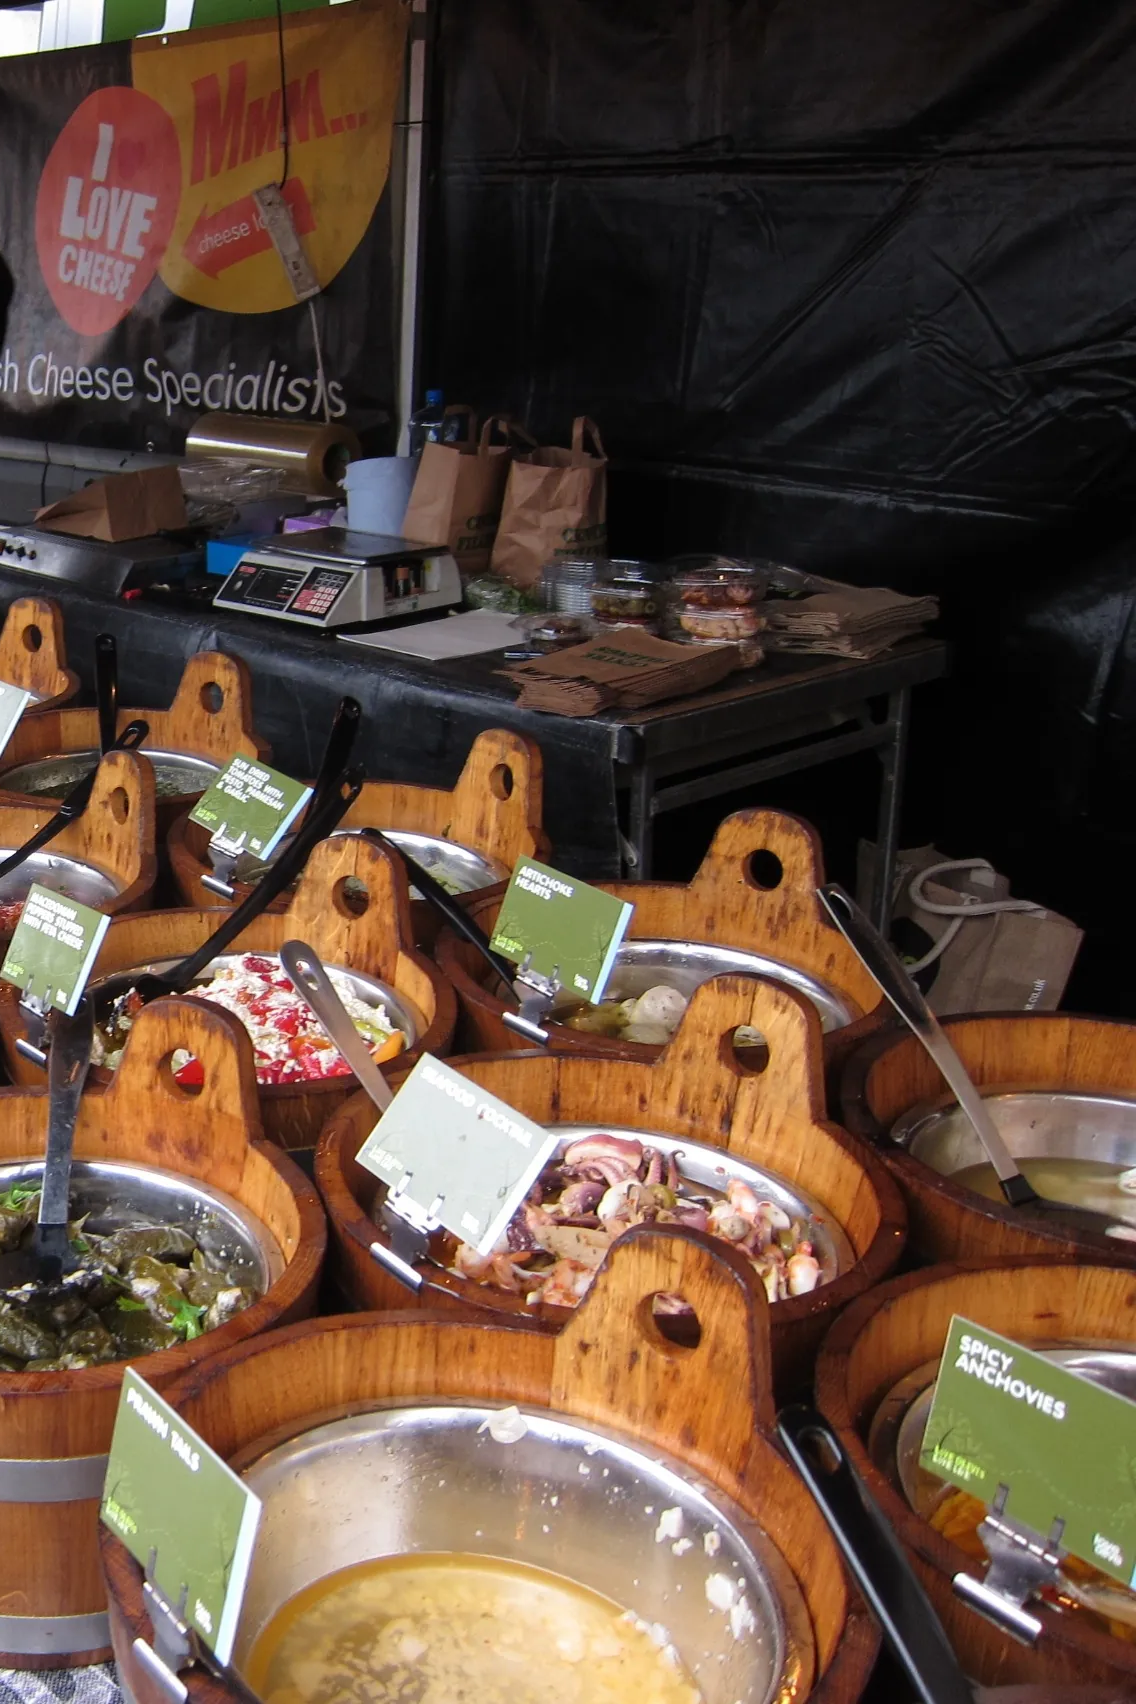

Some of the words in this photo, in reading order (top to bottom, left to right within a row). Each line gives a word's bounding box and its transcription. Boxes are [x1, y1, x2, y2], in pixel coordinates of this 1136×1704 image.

[91, 123, 113, 181] I
[58, 176, 158, 260] LOVE
[198, 221, 251, 254] cheese
[58, 248, 136, 302] CHEESE
[27, 353, 134, 401] Cheese
[143, 357, 347, 418] Specialists
[514, 876, 552, 900] HEARTS
[518, 866, 574, 898] ARTICHOKE
[959, 1335, 1014, 1372] SPICY
[955, 1353, 1065, 1420] ANCHOVIES
[127, 1388, 169, 1440] PRAWN
[171, 1430, 200, 1472] TAILS
